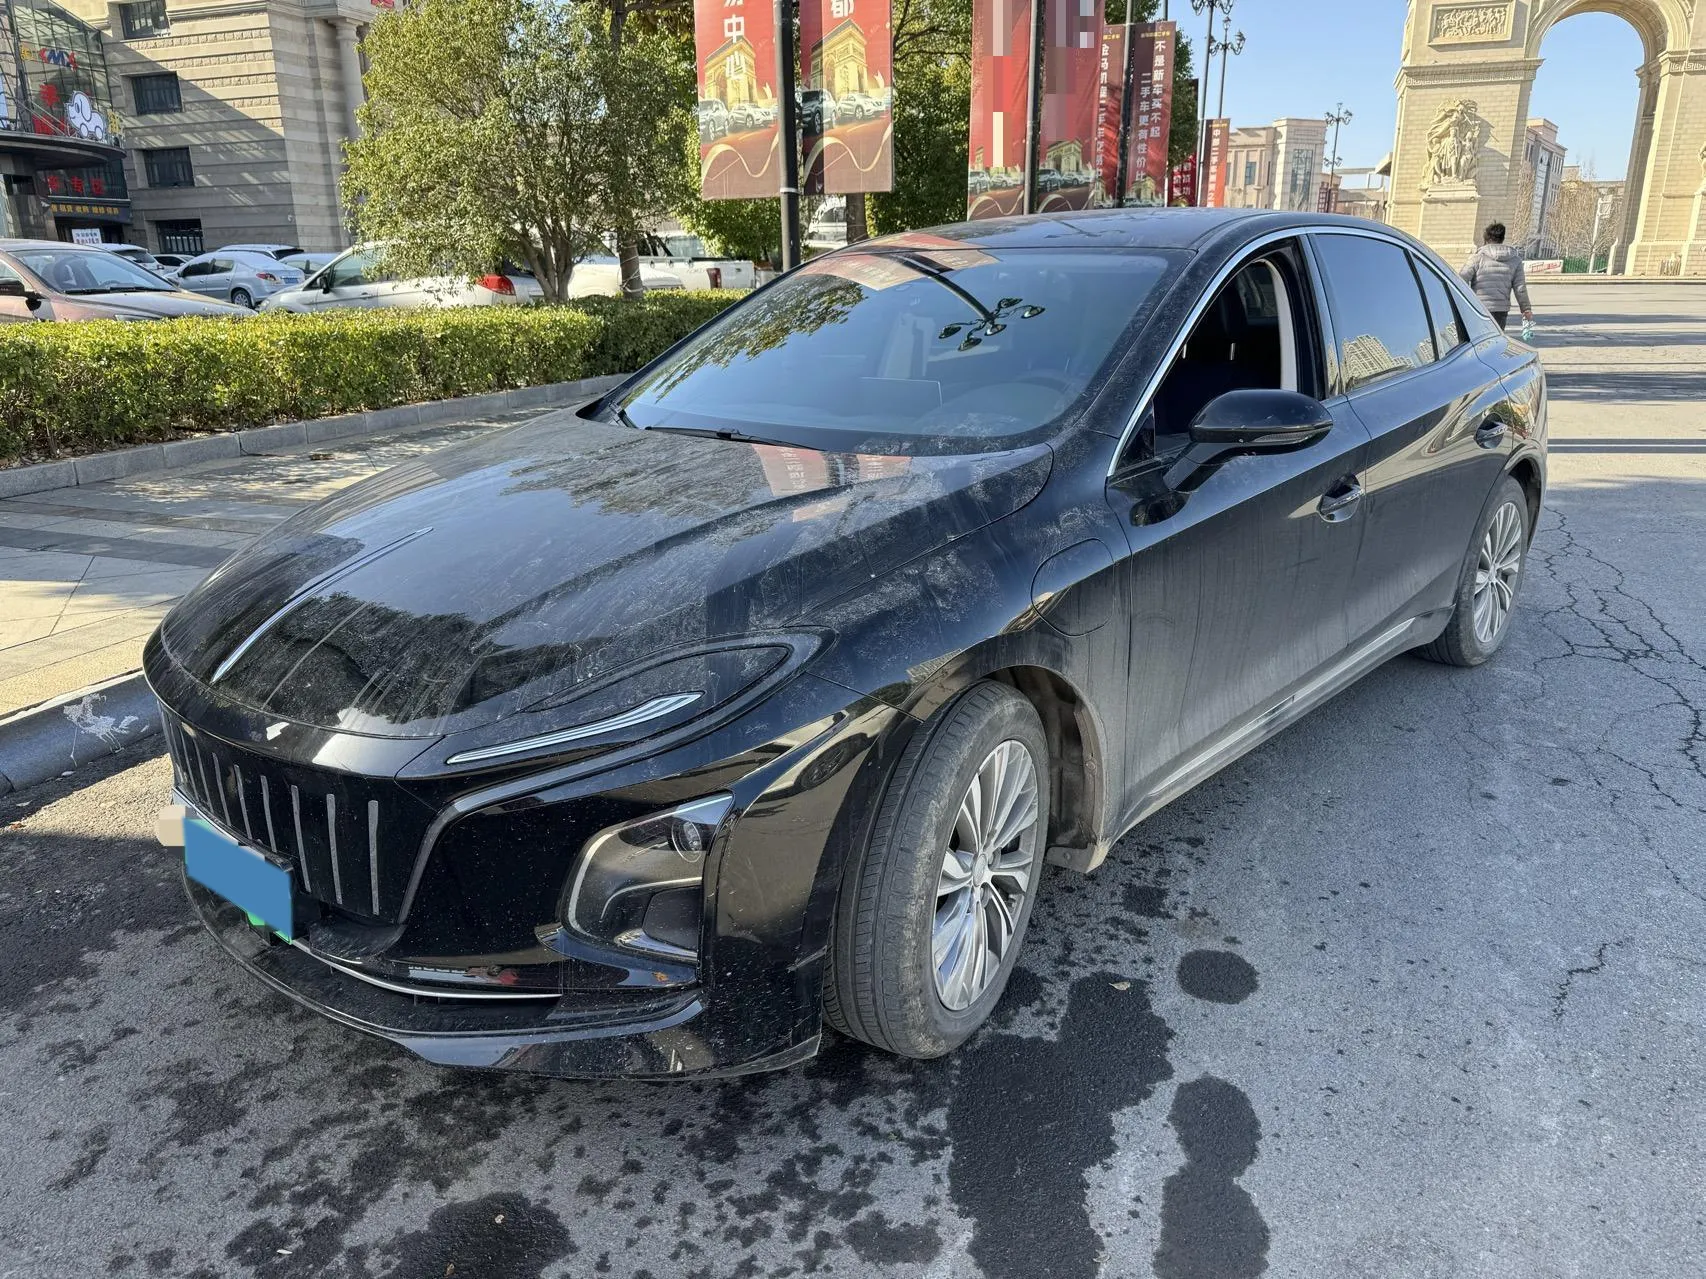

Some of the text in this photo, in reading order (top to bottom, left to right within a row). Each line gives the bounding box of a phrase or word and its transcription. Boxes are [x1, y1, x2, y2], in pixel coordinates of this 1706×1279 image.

[723, 0, 746, 80] 中心
[831, 0, 854, 18] 都
[1135, 72, 1152, 181] 二手车更有性价比
[1149, 40, 1166, 138] 不是新车买不起
